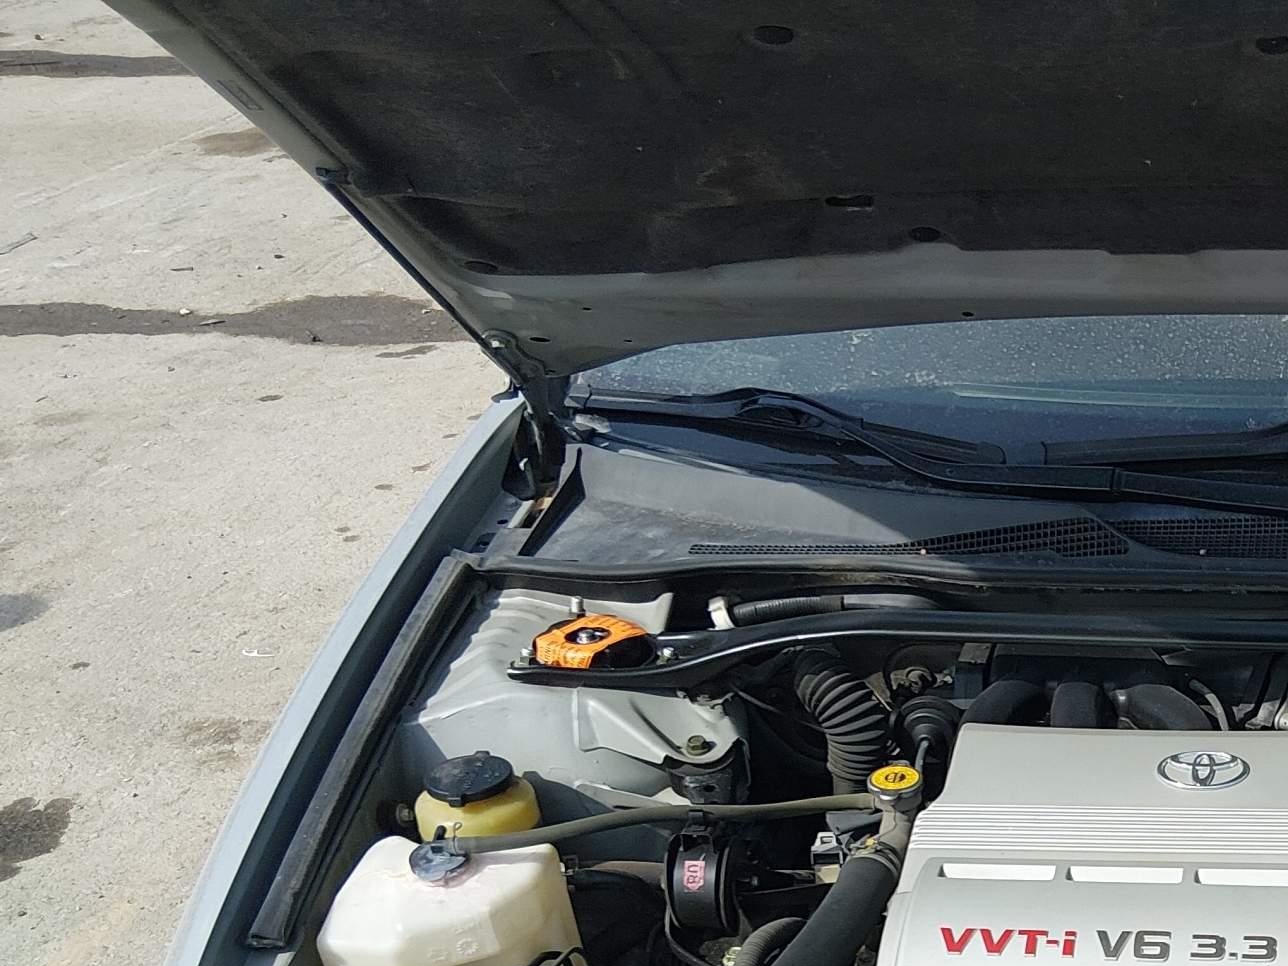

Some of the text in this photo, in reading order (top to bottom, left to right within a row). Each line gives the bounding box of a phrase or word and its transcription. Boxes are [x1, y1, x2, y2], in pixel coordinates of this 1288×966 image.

[941, 927, 1277, 962] VVT-i V6 3.3
